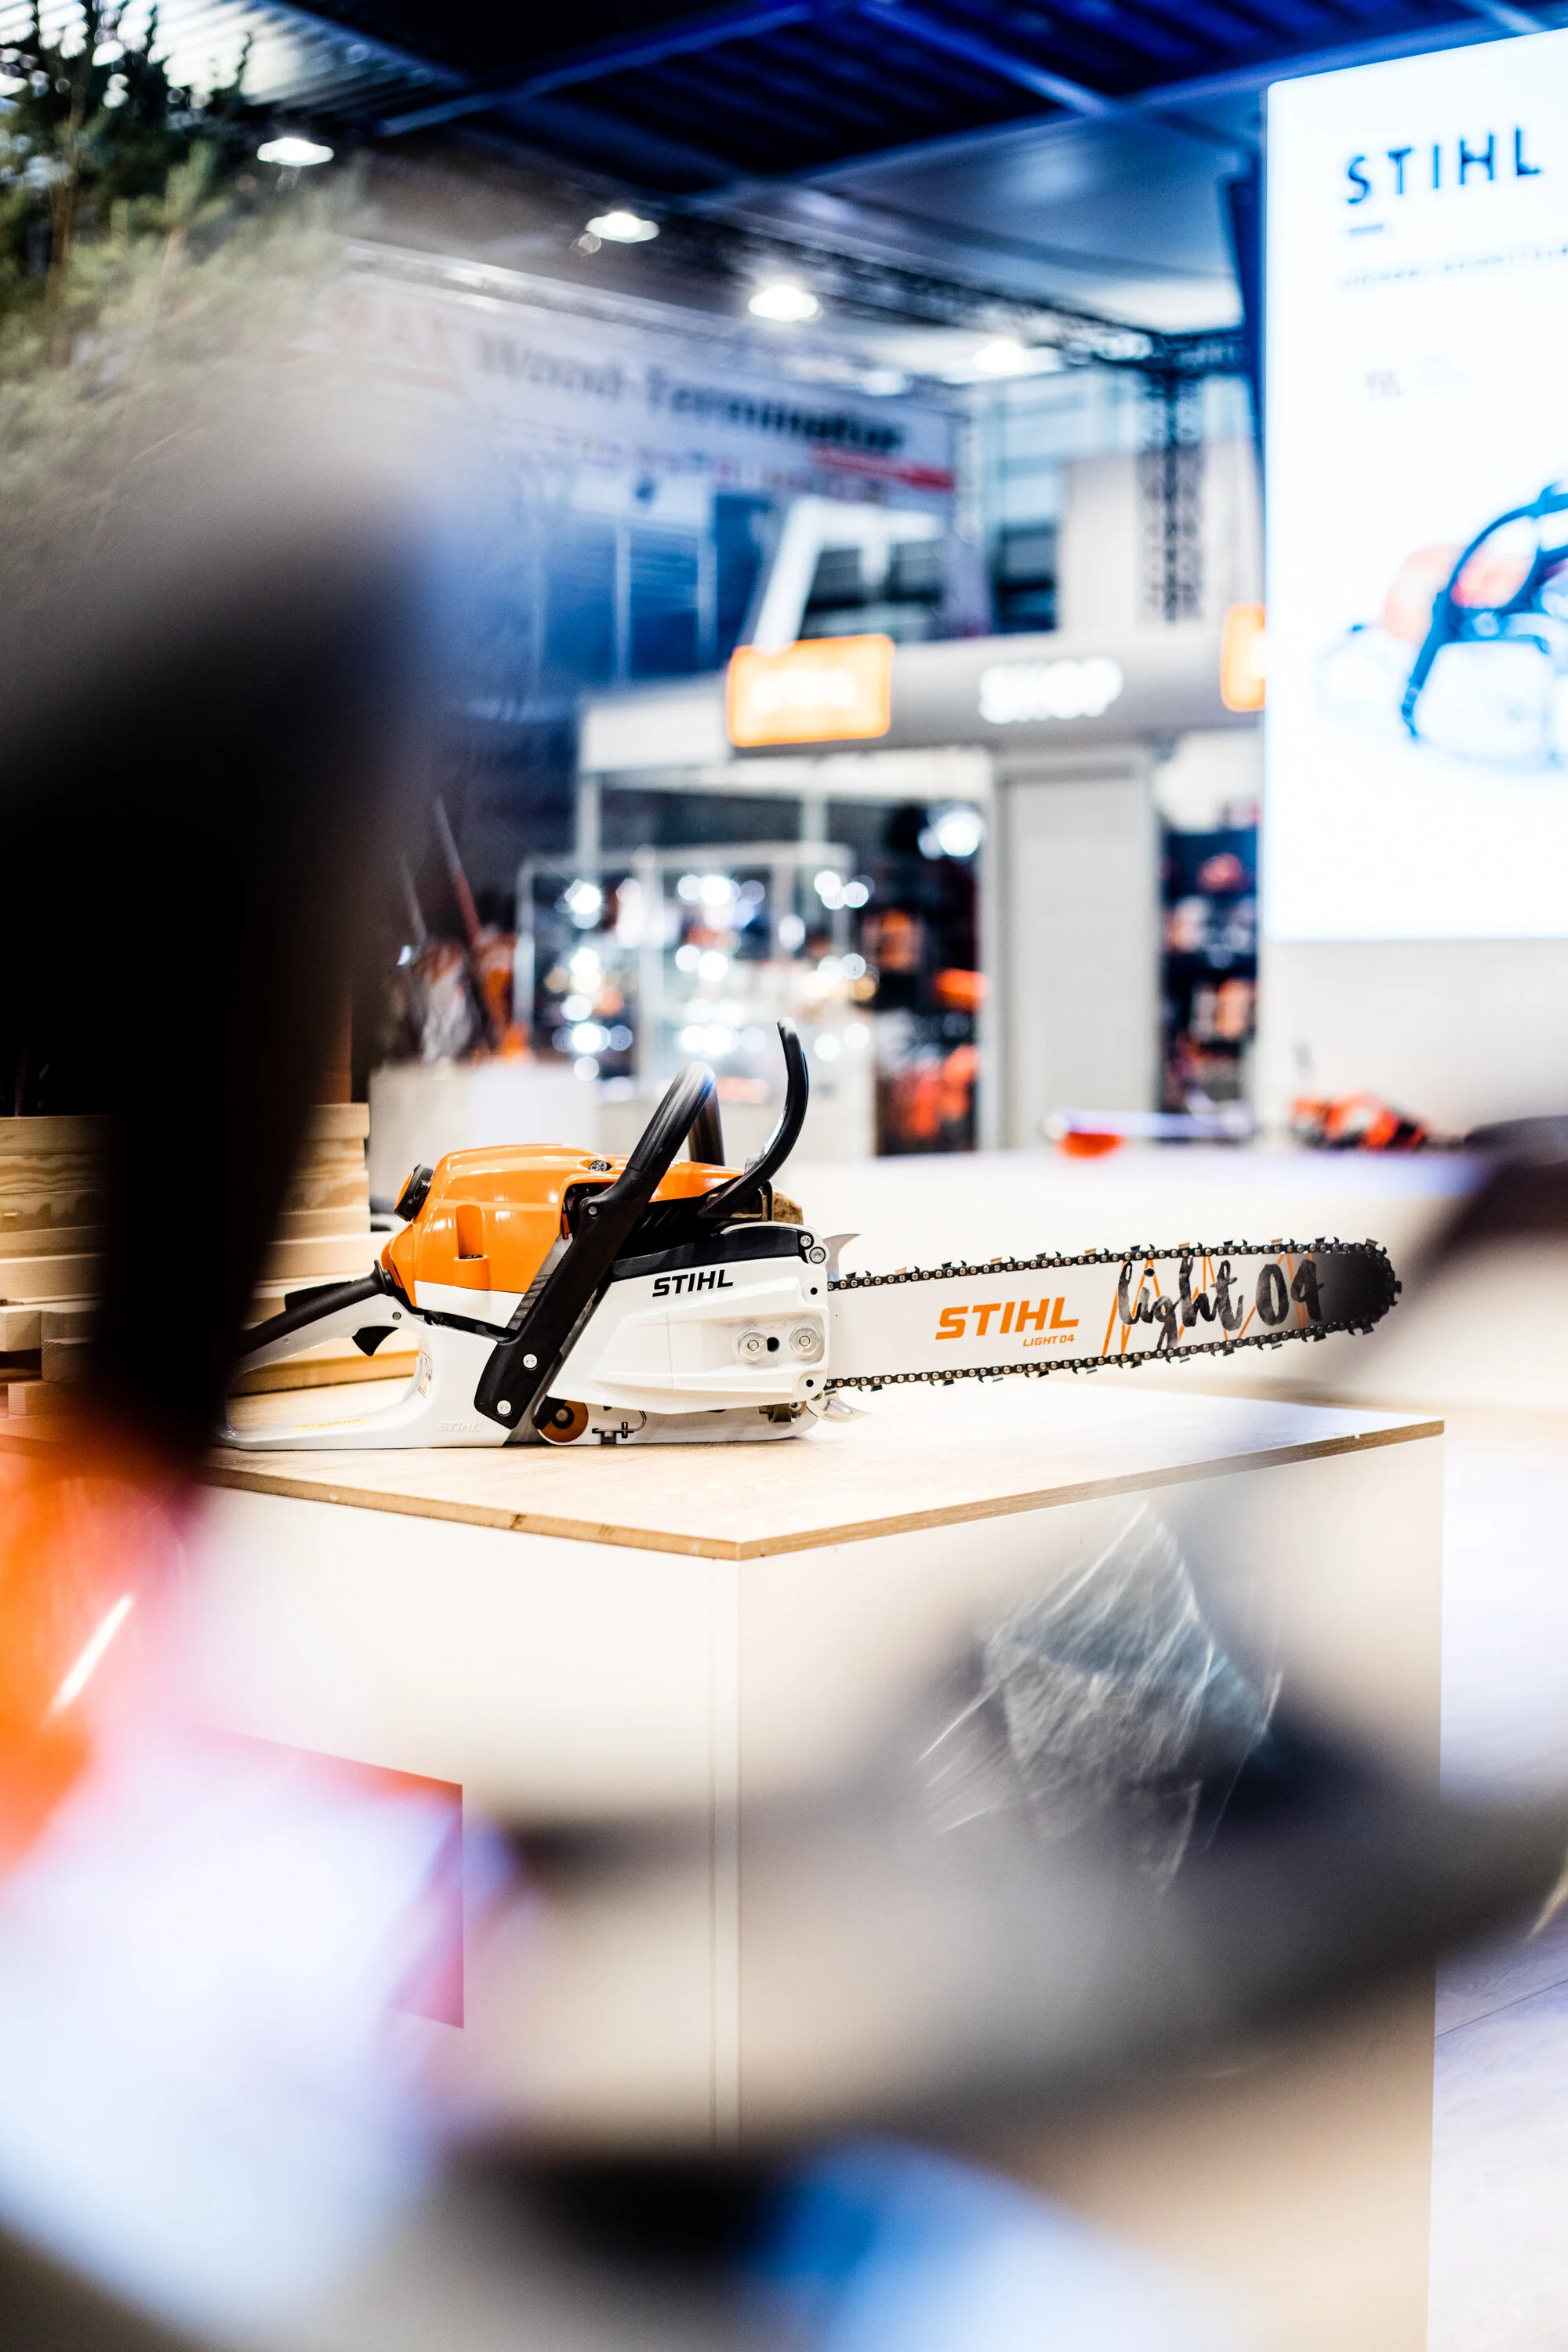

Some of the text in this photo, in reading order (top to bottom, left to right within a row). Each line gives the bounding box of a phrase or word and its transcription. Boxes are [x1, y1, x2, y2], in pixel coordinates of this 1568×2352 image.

[1347, 126, 1542, 205] STIHL
[652, 1269, 733, 1298] STIHL
[935, 1297, 1079, 1340] STIHL
[1118, 1255, 1243, 1350] light
[1022, 1334, 1075, 1347] LIGHT 04
[438, 1421, 481, 1432] STIHL
